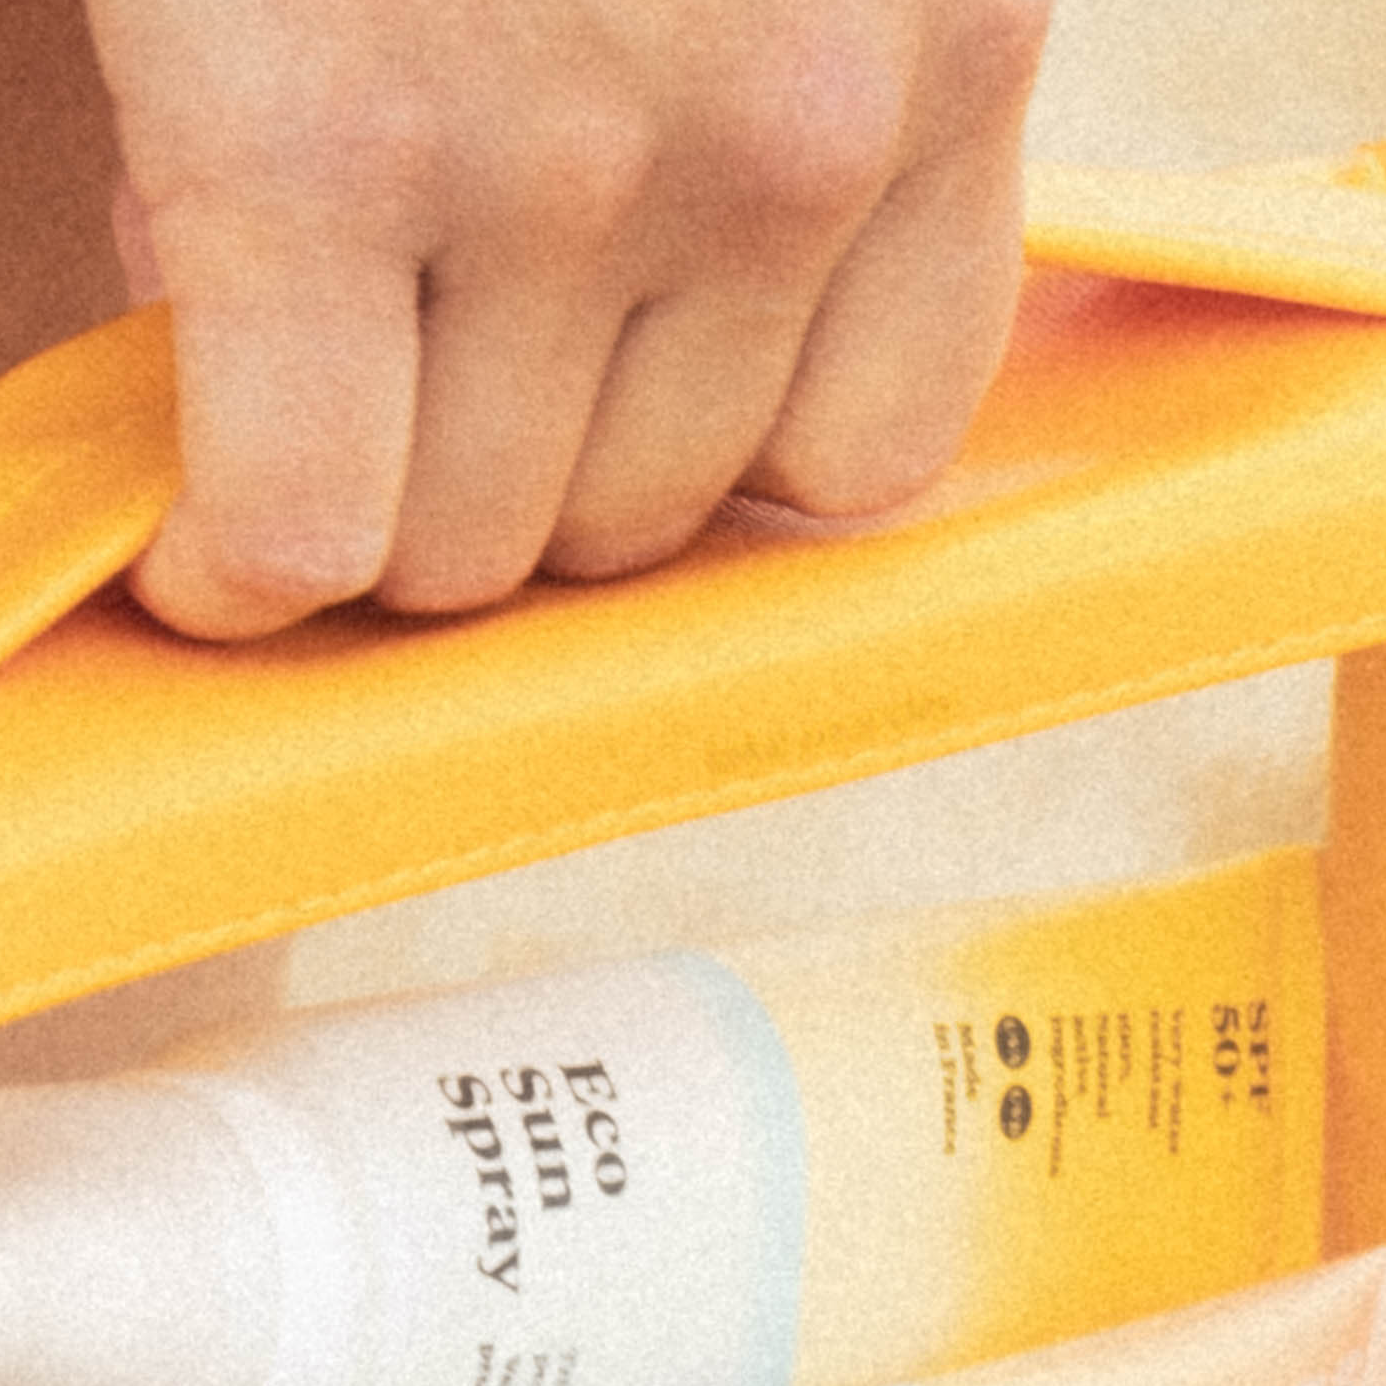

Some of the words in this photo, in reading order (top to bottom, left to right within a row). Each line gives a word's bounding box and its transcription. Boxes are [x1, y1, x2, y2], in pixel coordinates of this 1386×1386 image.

[941, 1059, 956, 1154] France
[1213, 1003, 1240, 1109] 50+
[1248, 1001, 1273, 1114] SPF
[437, 1072, 519, 1294] Spray
[499, 1066, 572, 1211] Sun
[559, 1059, 627, 1196] Eco
